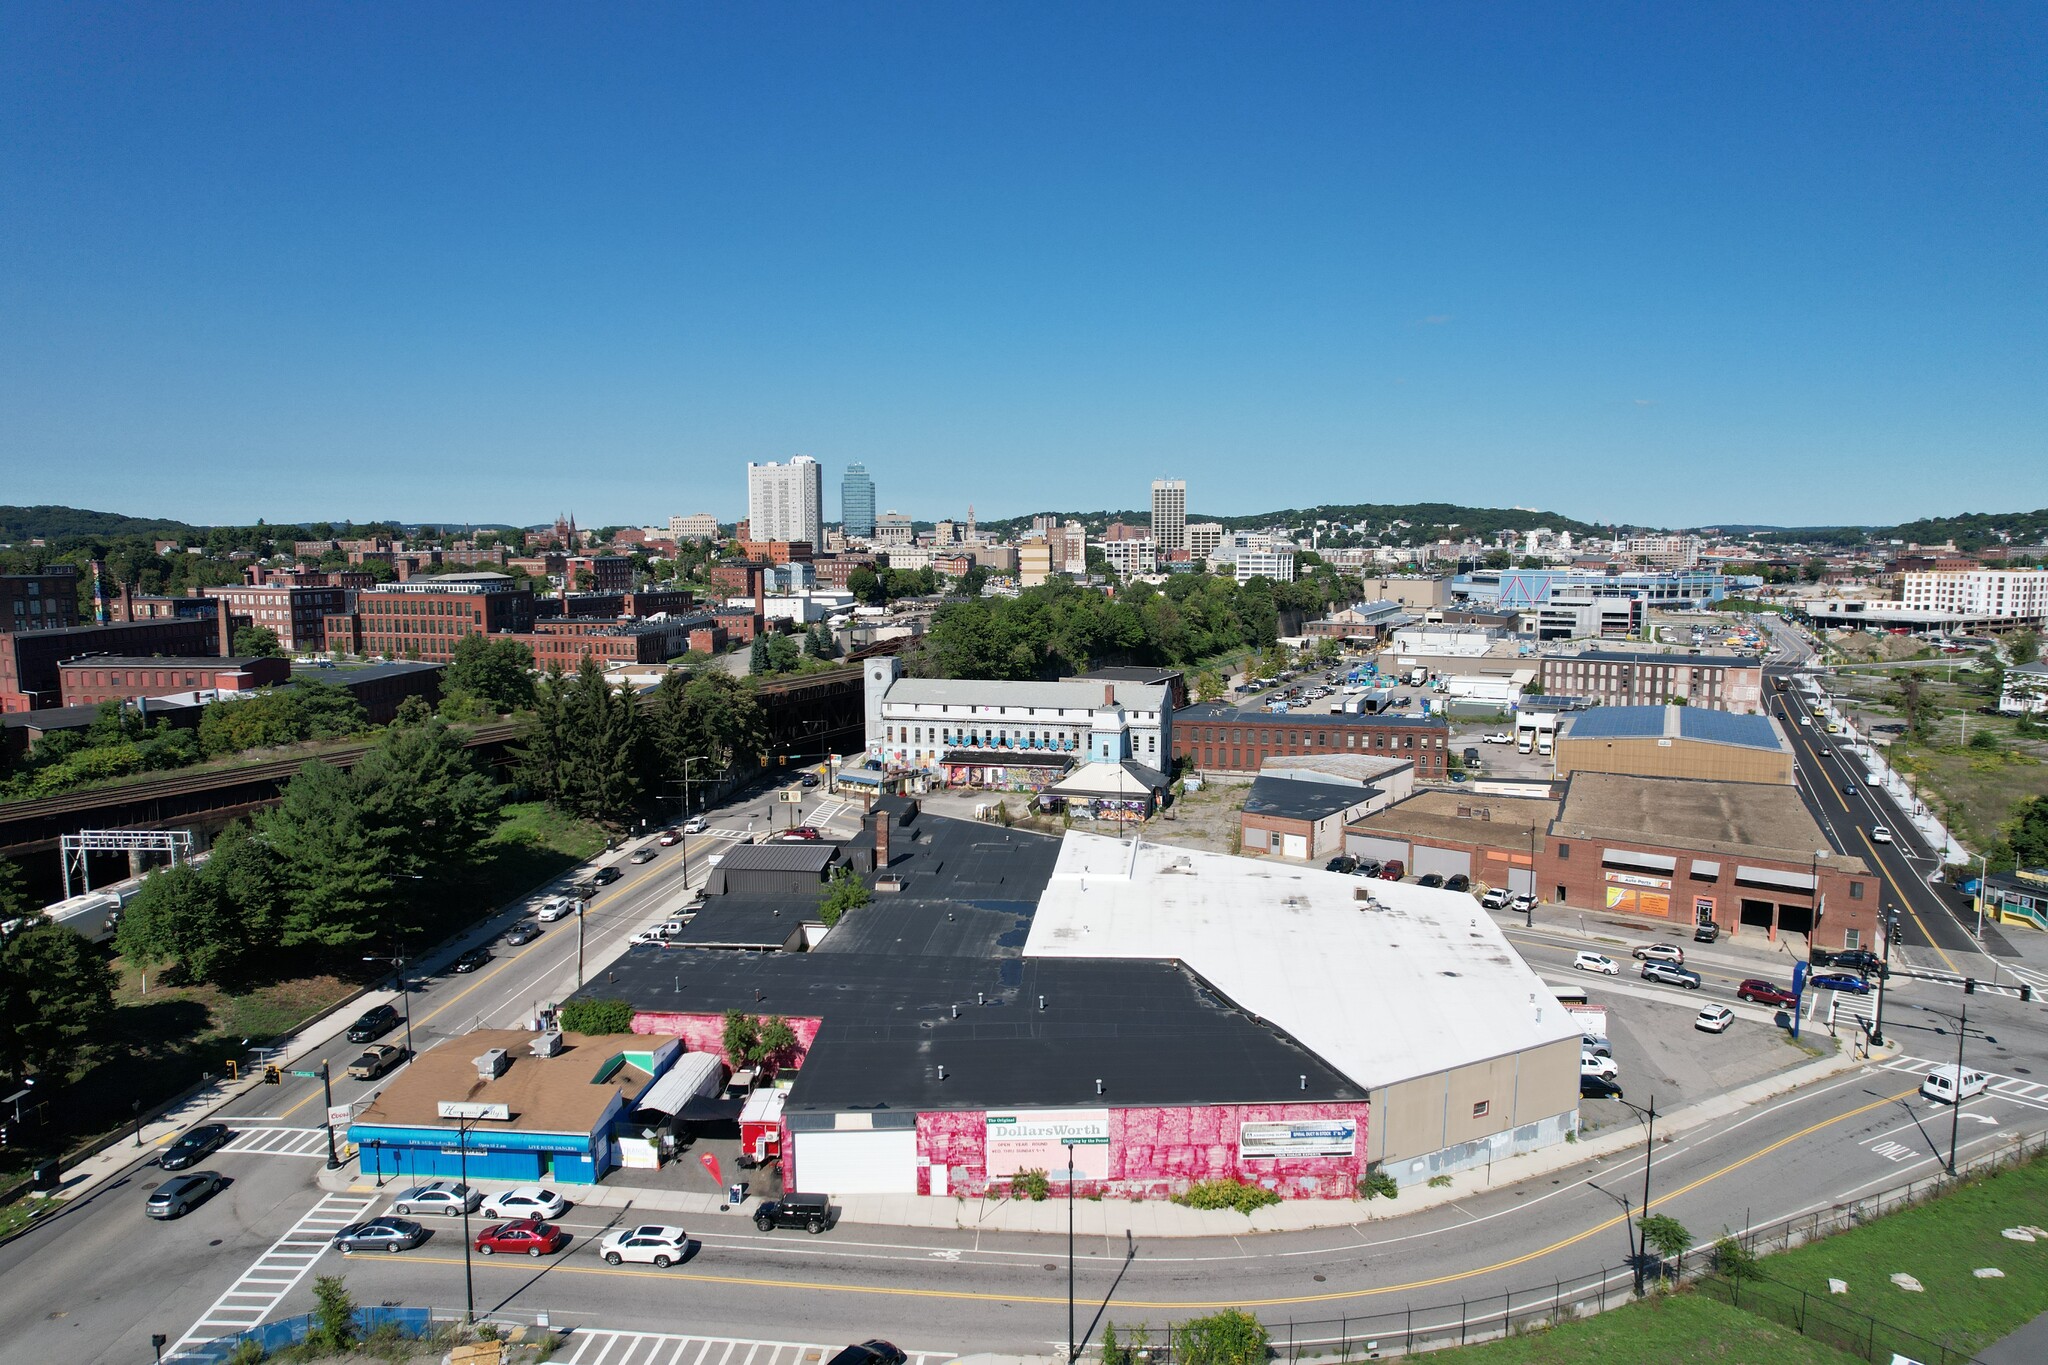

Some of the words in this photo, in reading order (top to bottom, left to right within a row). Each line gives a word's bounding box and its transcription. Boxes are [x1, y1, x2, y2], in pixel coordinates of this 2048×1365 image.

[444, 1105, 479, 1115] Hurrcane
[996, 1124, 1101, 1137] DollarsWorth
[1871, 1141, 1921, 1162] ONLY
